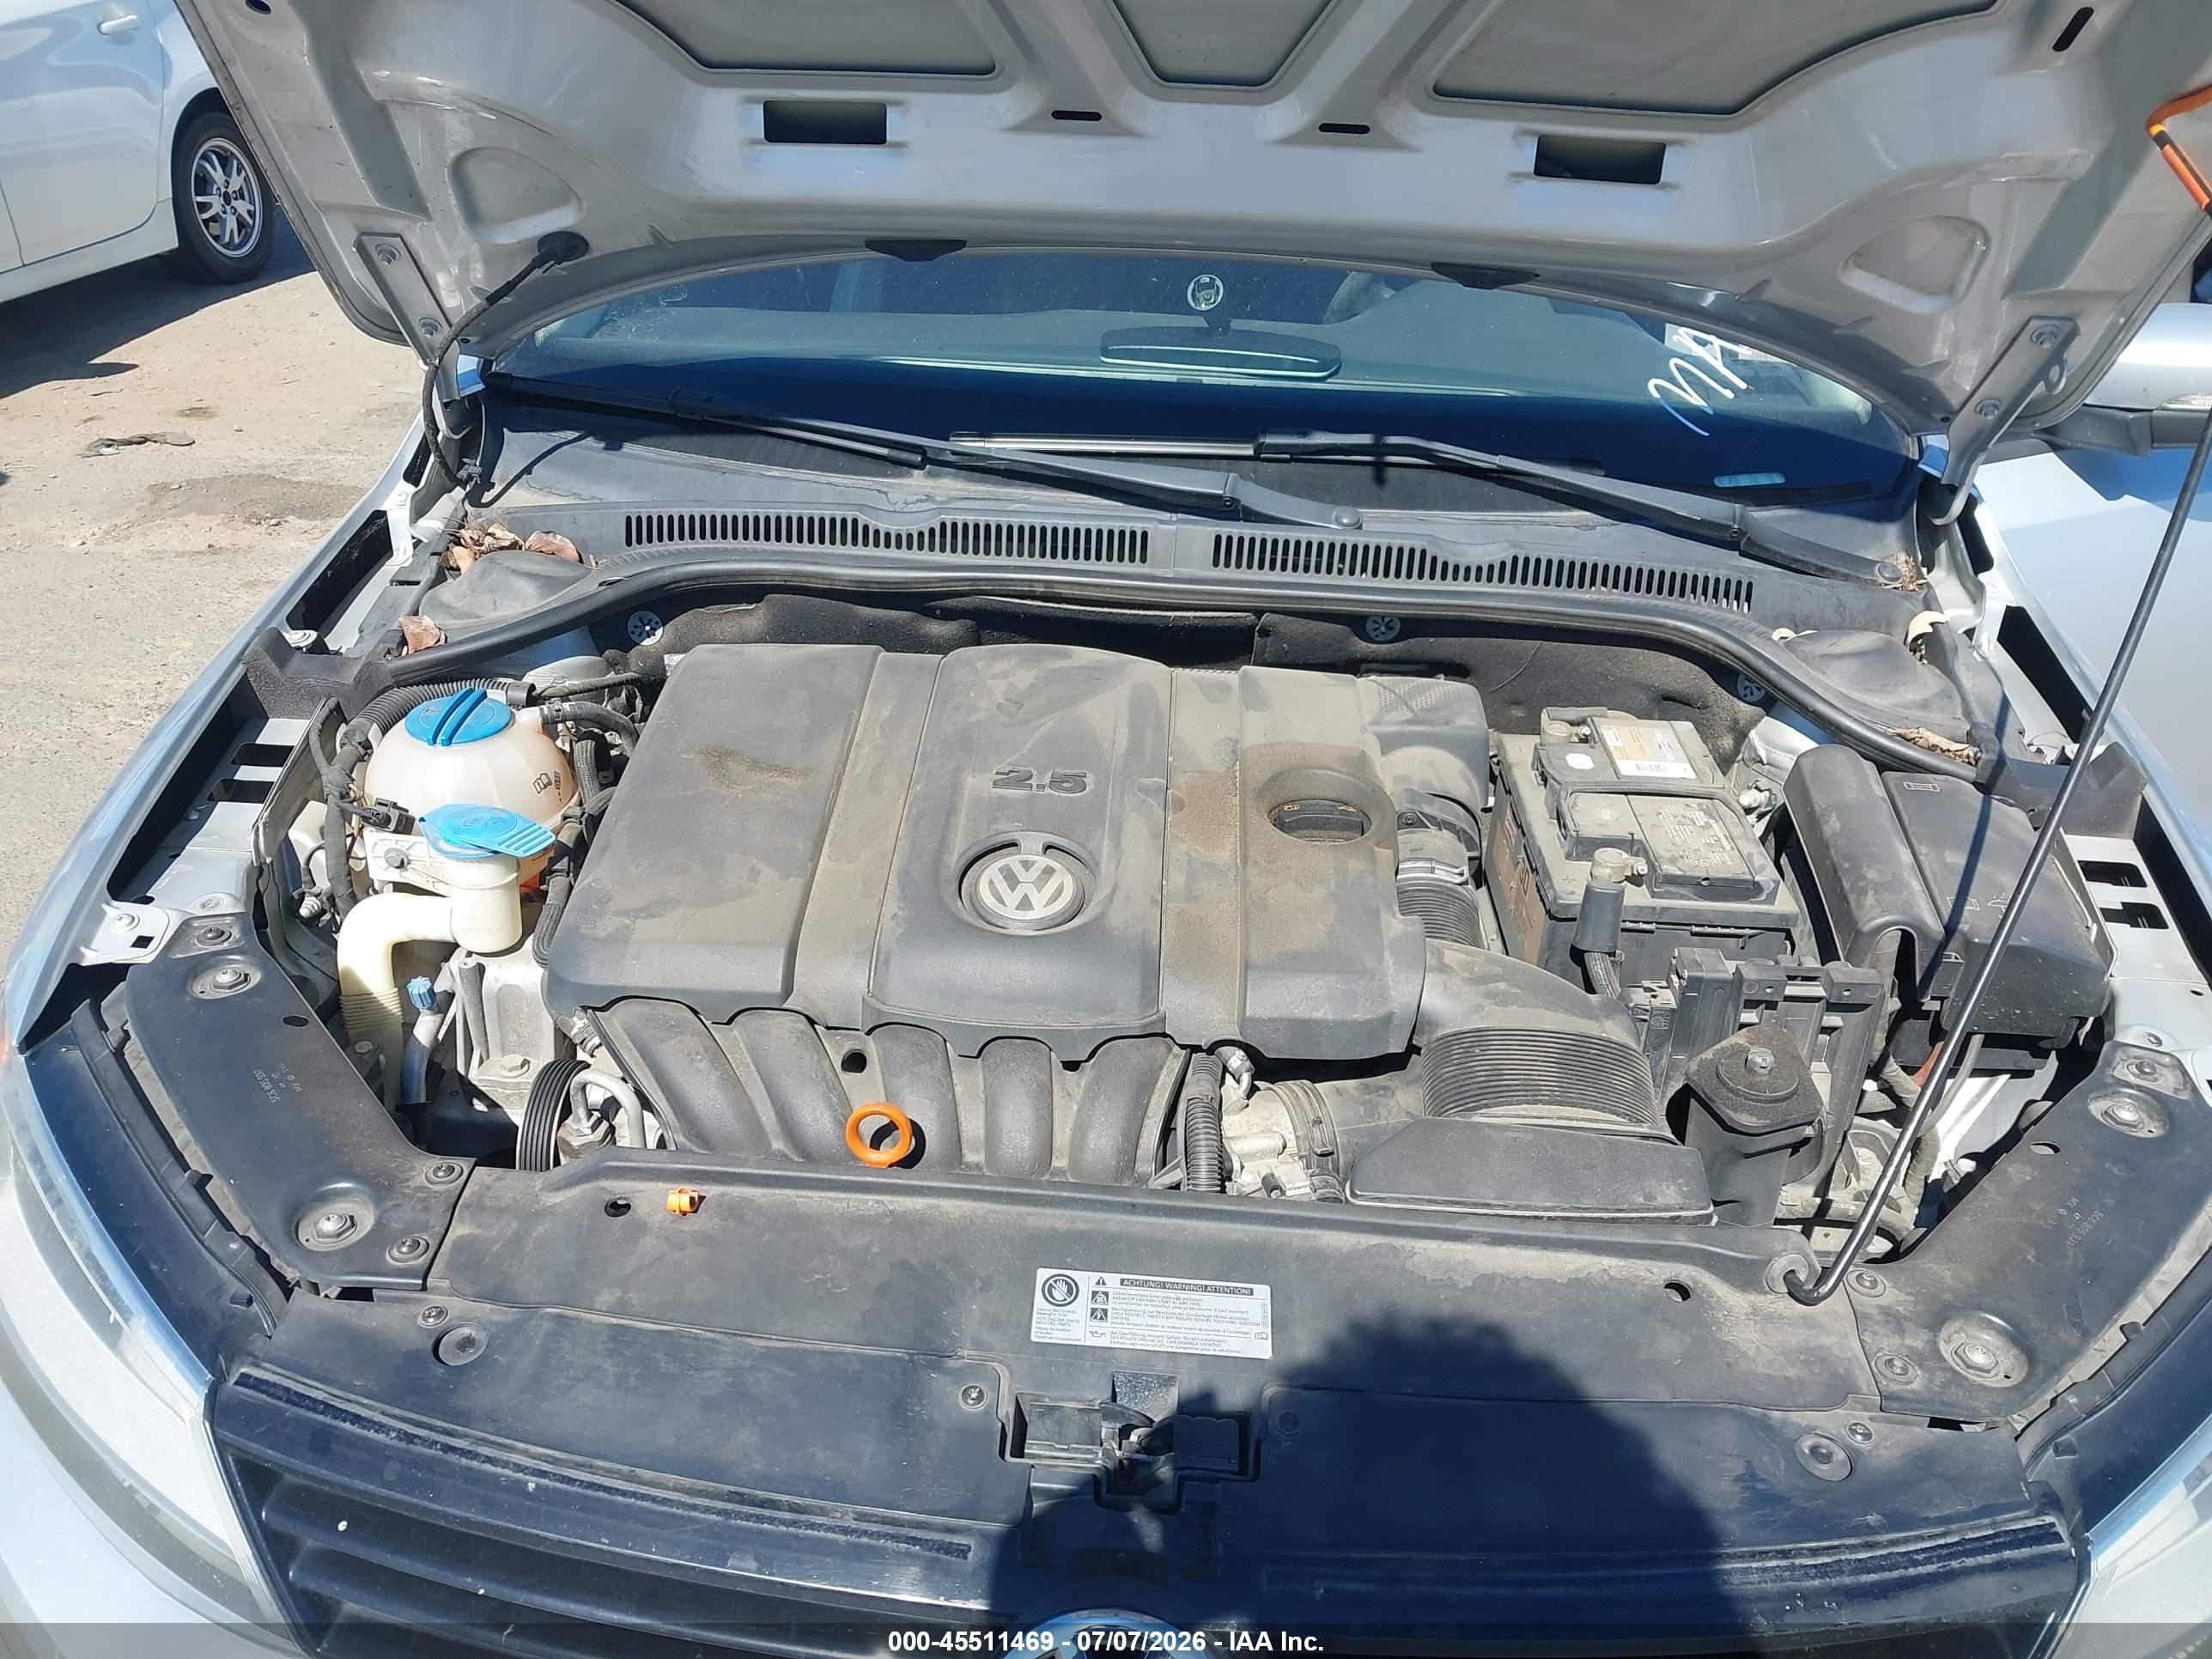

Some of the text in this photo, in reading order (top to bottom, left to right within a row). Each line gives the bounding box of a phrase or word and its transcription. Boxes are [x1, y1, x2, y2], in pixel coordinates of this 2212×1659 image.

[992, 770, 1087, 793] 2.5
[1123, 1279, 1250, 1295] ACHTUNG! WARNING! ATTENTION!
